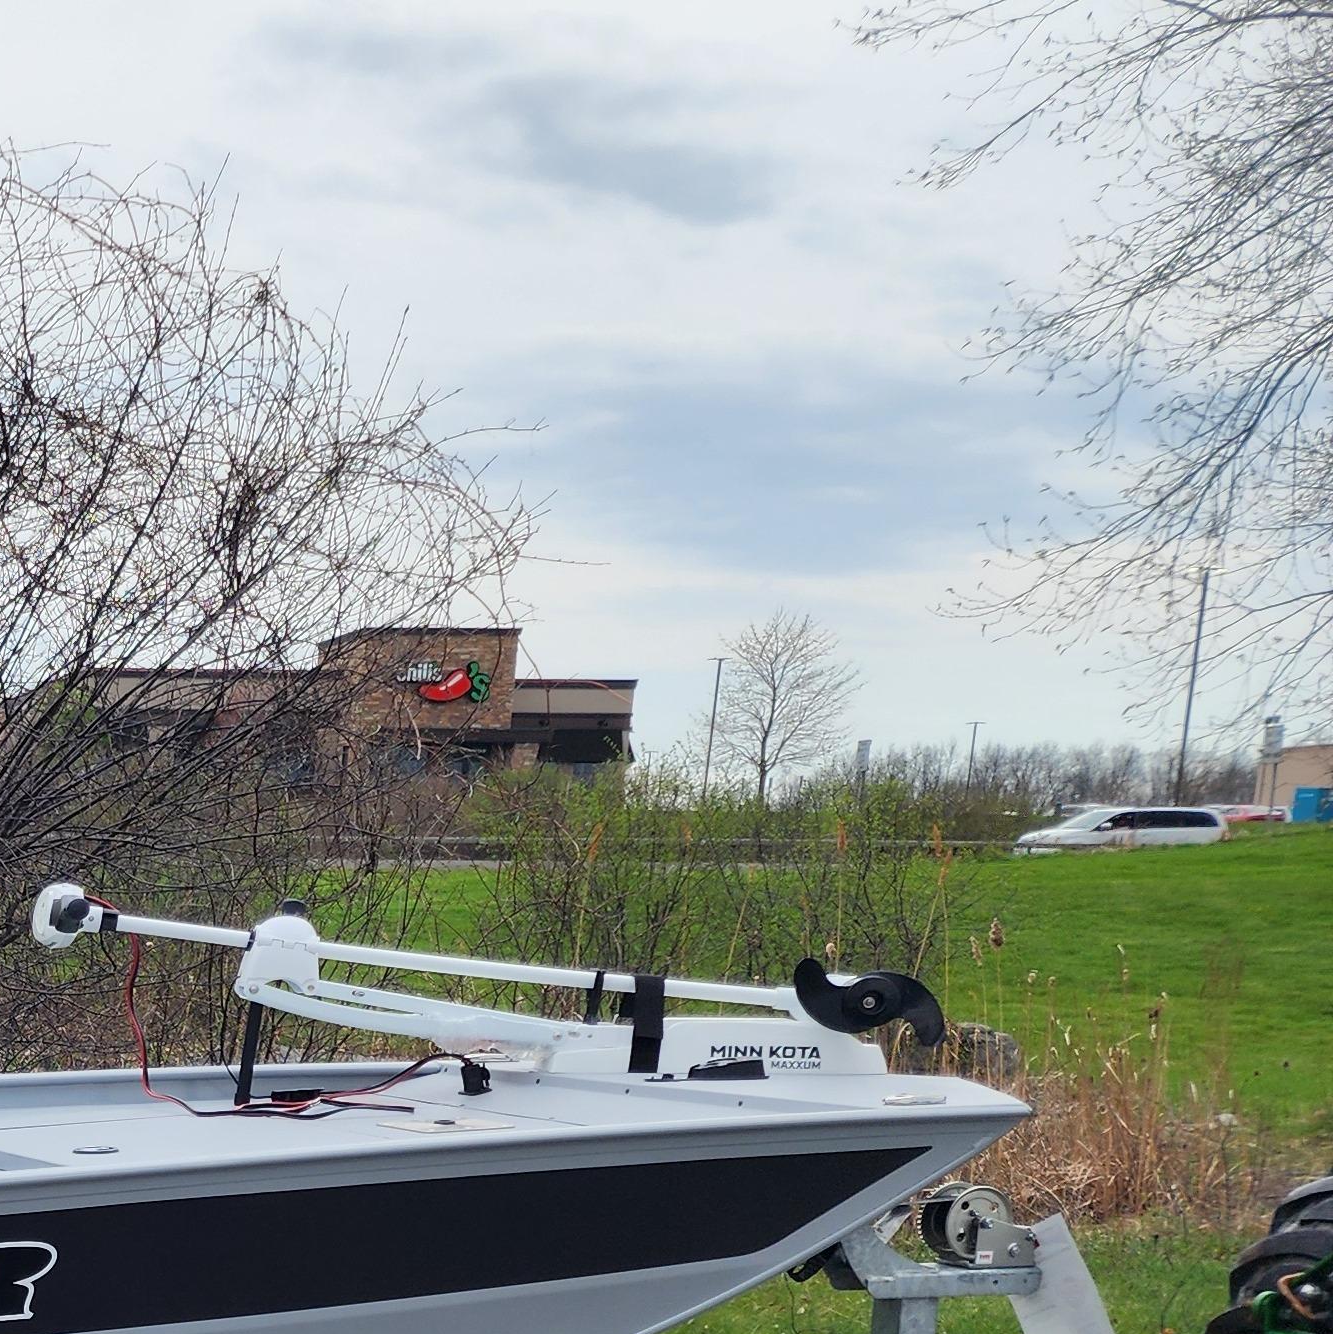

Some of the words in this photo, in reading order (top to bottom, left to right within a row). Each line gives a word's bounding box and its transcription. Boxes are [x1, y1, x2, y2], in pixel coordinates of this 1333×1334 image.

[710, 1045, 763, 1058] MINN
[769, 1045, 821, 1059] KOTA
[771, 1061, 821, 1070] MAXXUM
